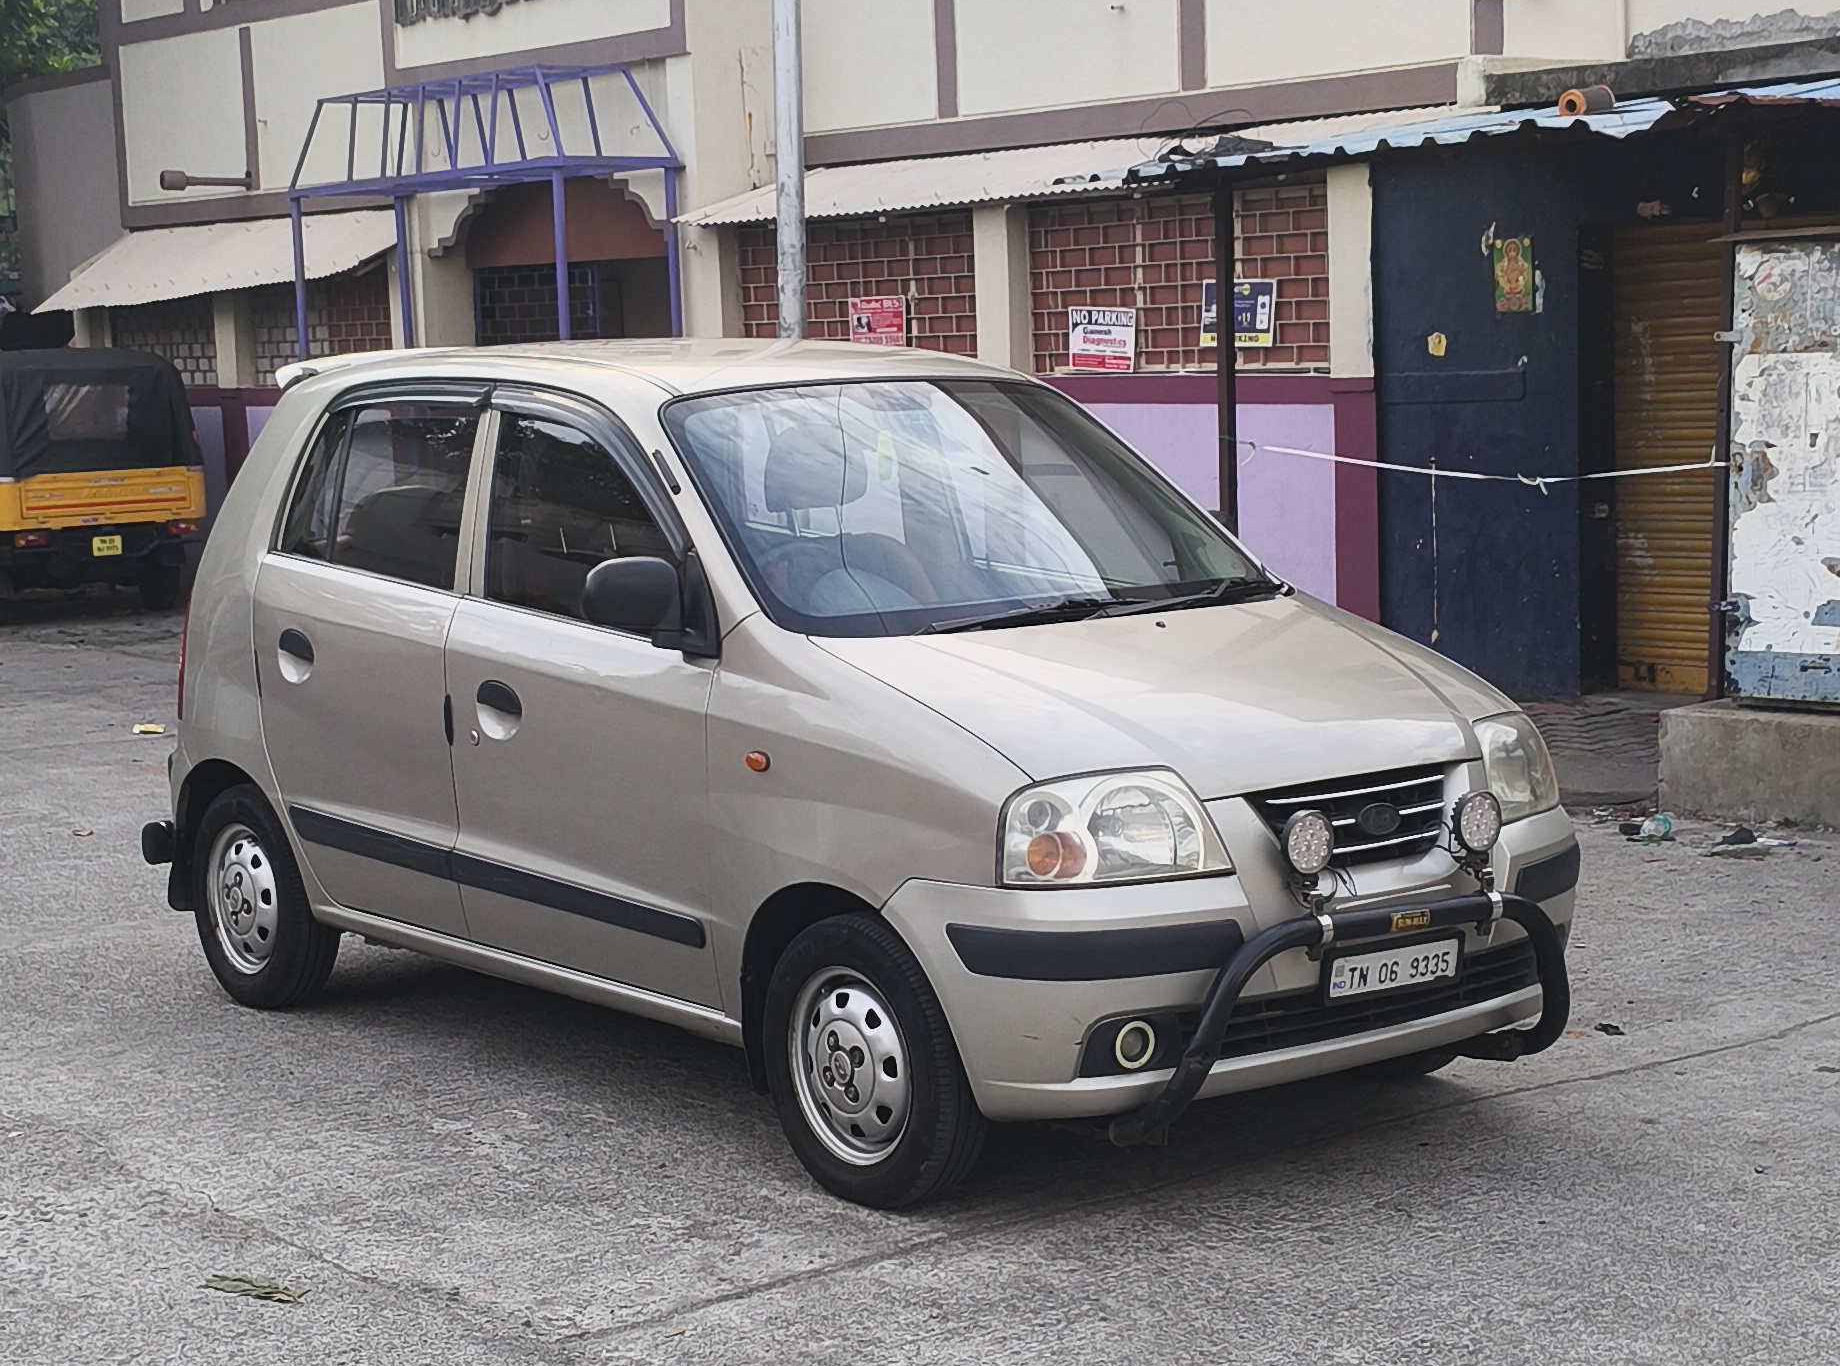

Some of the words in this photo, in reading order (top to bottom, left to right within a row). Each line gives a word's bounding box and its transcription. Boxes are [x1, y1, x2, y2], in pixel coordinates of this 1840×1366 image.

[1072, 309, 1089, 324] NO
[1091, 310, 1134, 326] PARKING
[1349, 966, 1369, 989] TN
[1379, 961, 1399, 984] 06
[1410, 952, 1450, 978] 9335
[1332, 981, 1346, 990] IND
